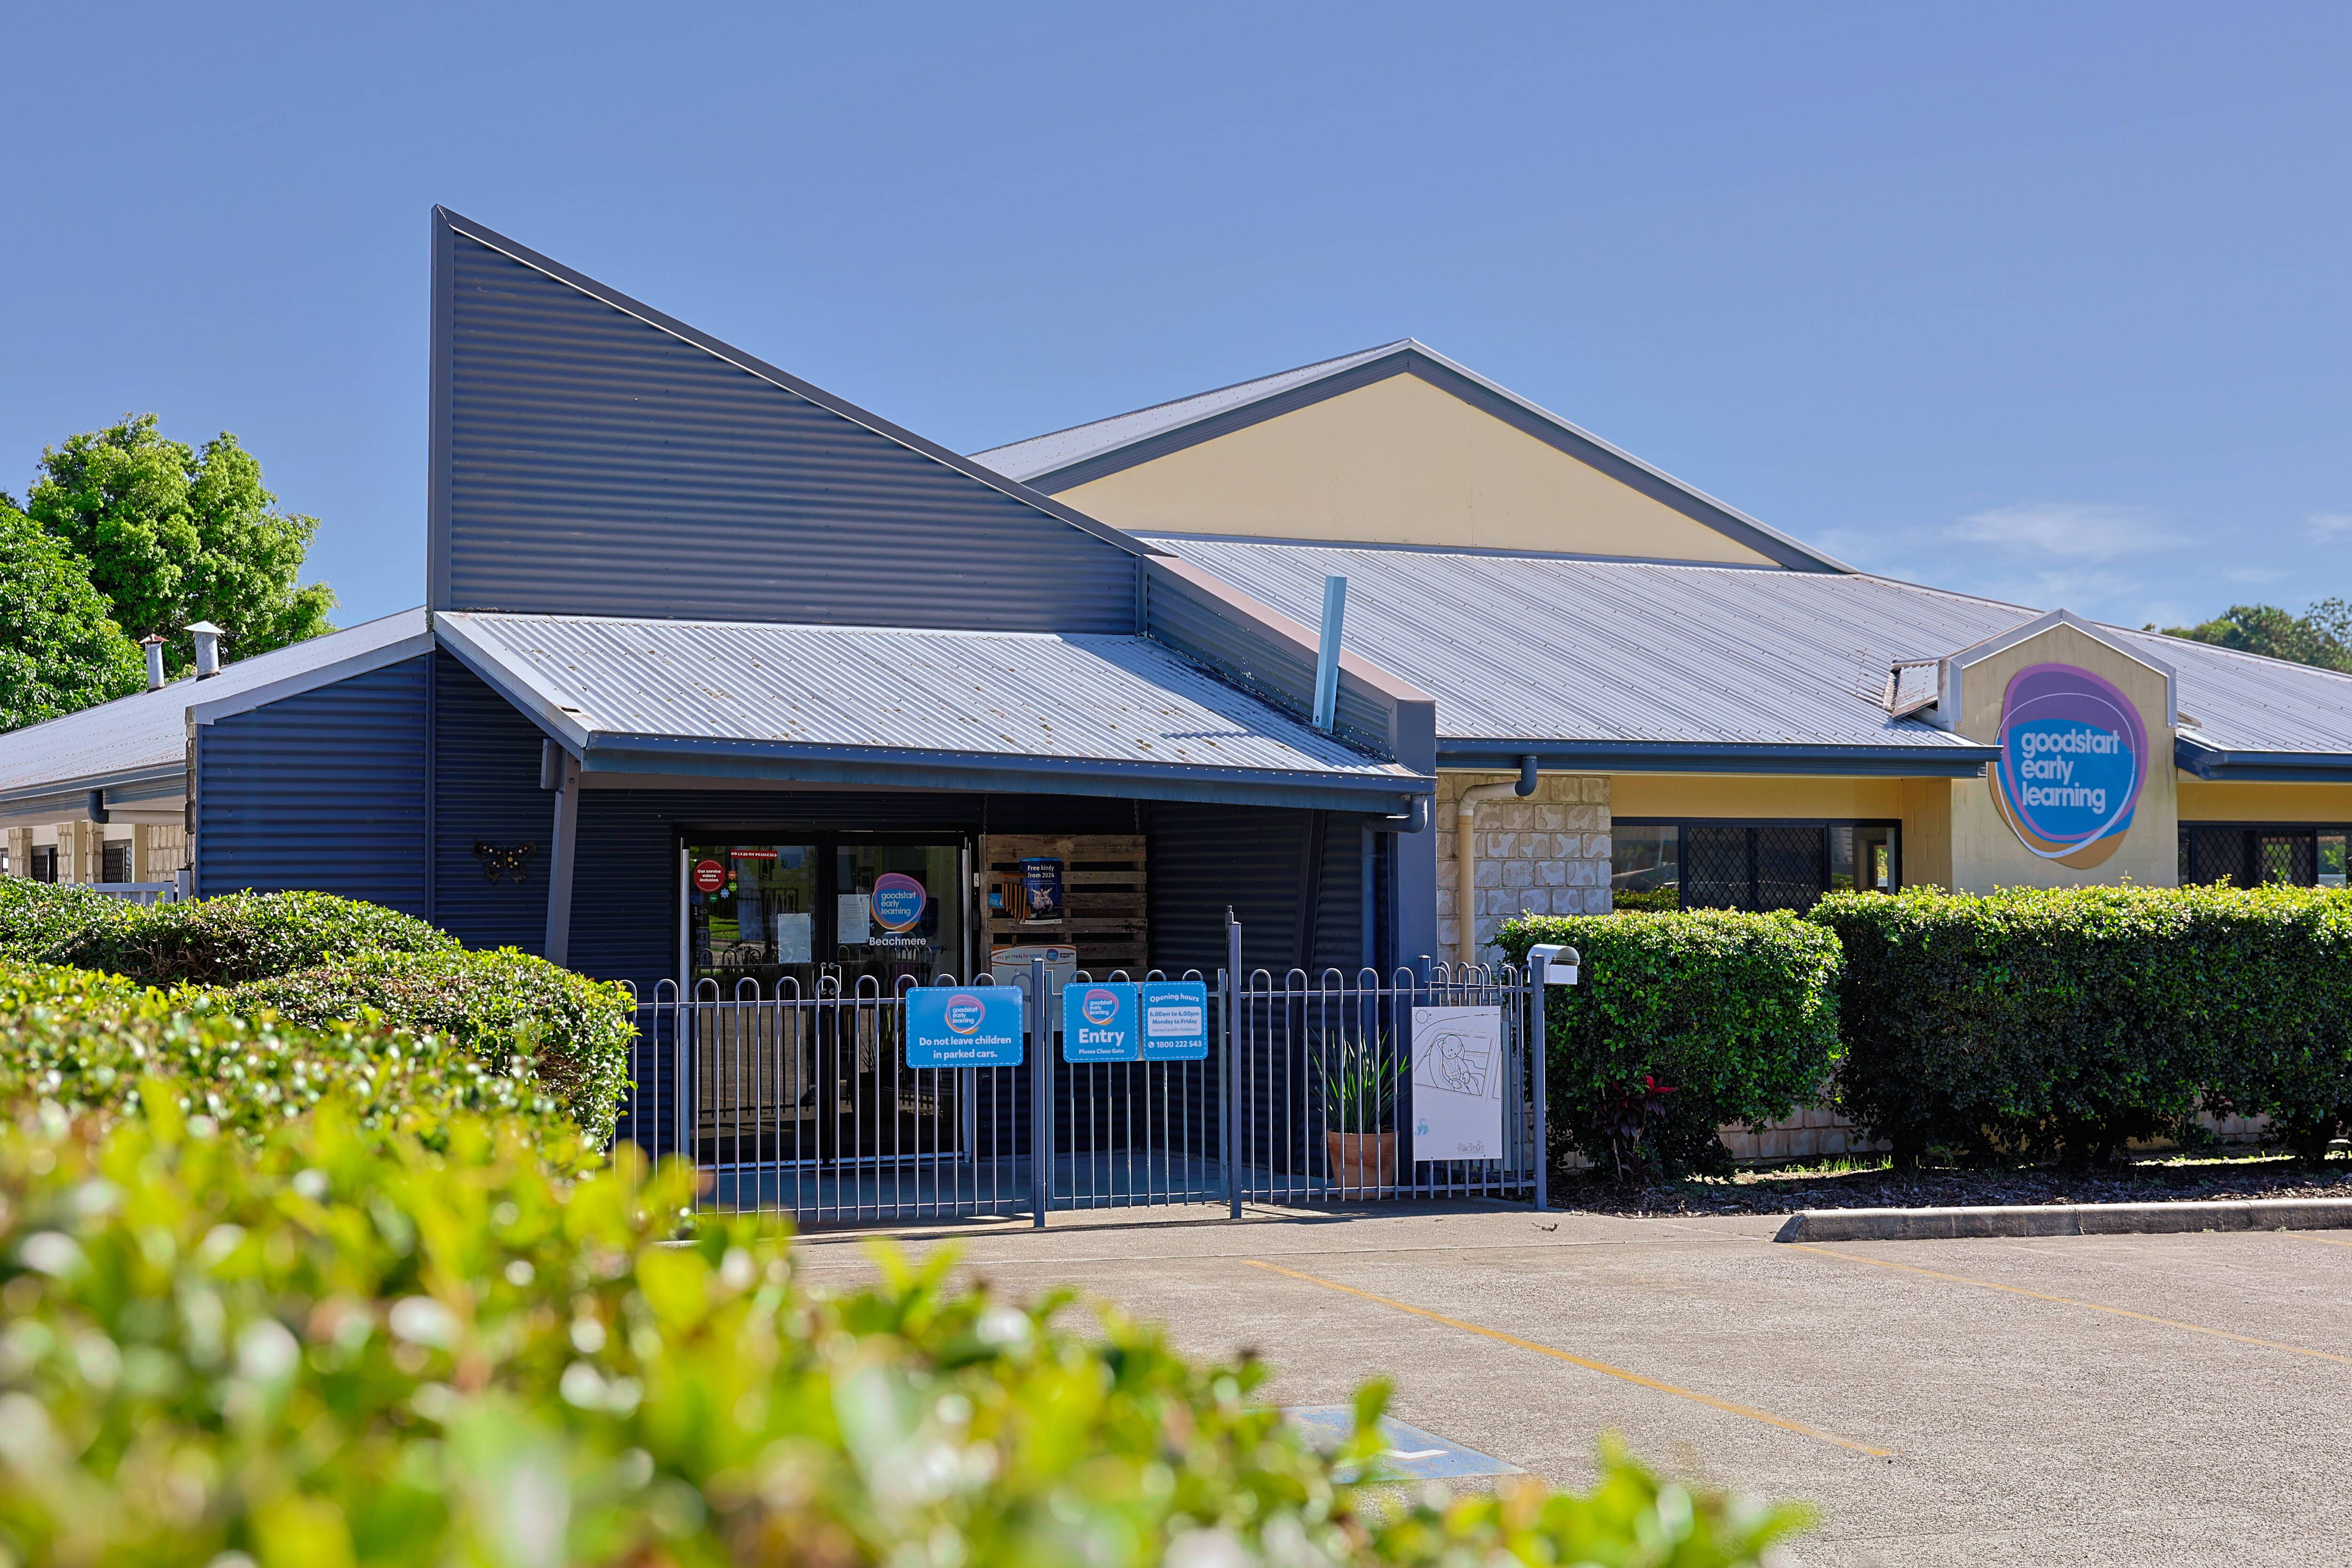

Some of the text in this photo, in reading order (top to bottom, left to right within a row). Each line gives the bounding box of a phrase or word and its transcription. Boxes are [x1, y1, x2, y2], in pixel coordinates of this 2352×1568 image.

[2021, 729, 2120, 758] goodstart
[2021, 755, 2074, 785] early
[2022, 781, 2106, 814] learning
[881, 891, 916, 901] goodstart
[881, 899, 899, 908] early
[881, 907, 911, 916] learning
[869, 937, 926, 946] Beachmere
[1150, 993, 1200, 1003] Opening hours
[919, 1035, 1011, 1046] Do not leave children
[1079, 1028, 1125, 1047] Entry
[933, 1050, 942, 1059] in
[944, 1049, 975, 1061] parked
